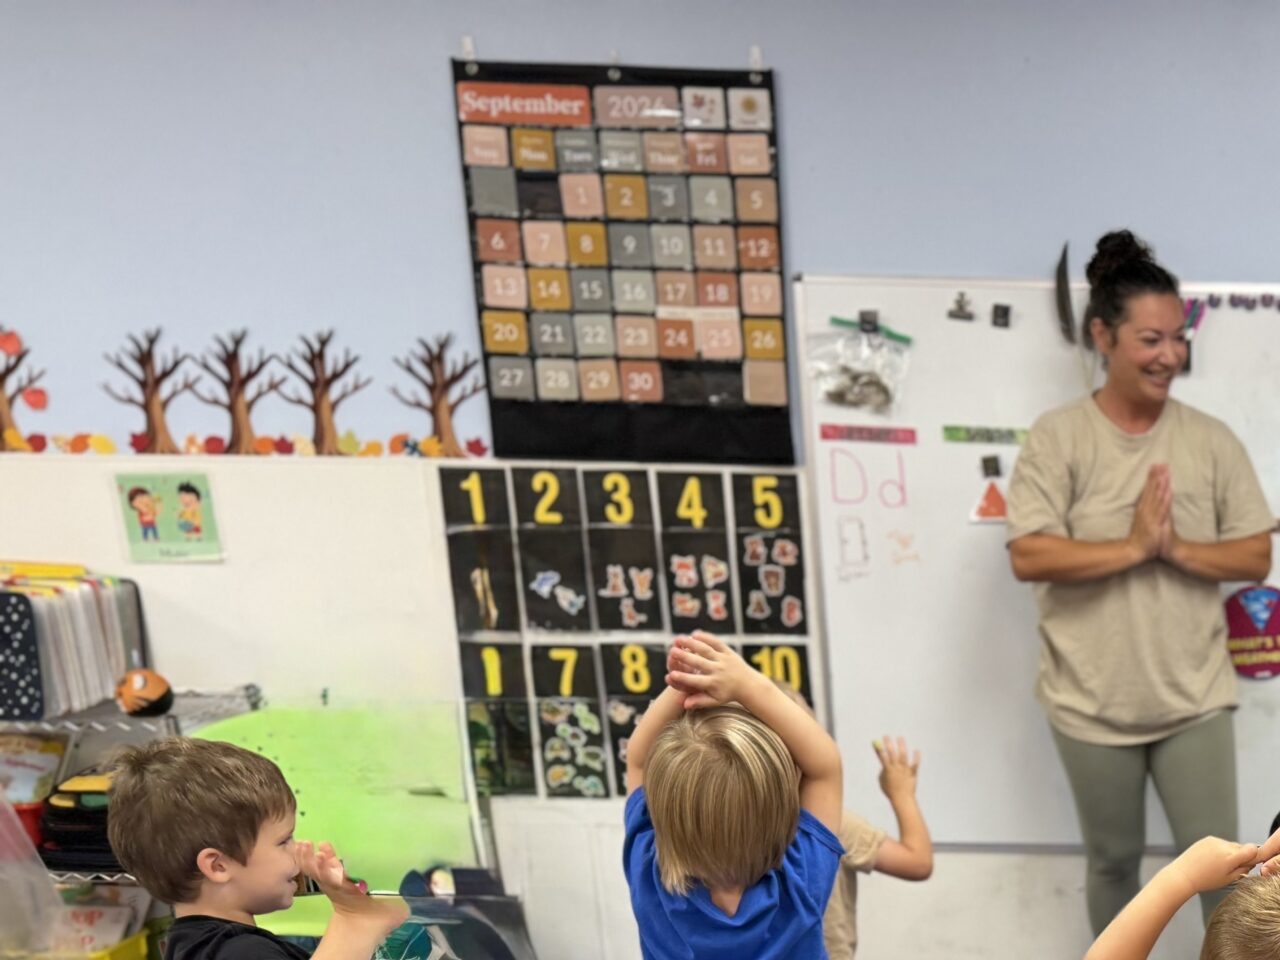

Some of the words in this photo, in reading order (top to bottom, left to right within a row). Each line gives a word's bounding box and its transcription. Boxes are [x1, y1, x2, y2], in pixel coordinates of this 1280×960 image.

[462, 89, 584, 117] September
[575, 187, 587, 204] 1
[619, 187, 633, 206] 2
[661, 187, 675, 206] 3
[704, 189, 717, 207] 4
[750, 191, 763, 209] 5
[490, 232, 505, 250] 6
[537, 234, 551, 252] 7
[580, 234, 594, 253] 8
[623, 235, 637, 253] 9
[660, 236, 683, 255] 10
[703, 237, 725, 257] 11
[748, 238, 770, 258] 12
[493, 278, 518, 296] 13
[536, 280, 561, 298] 14
[580, 281, 604, 299] 15
[622, 281, 647, 300] 16
[664, 282, 687, 300] 17
[705, 283, 729, 301] 18
[750, 284, 773, 303] 19
[493, 323, 519, 342] 20
[540, 325, 564, 343] 21
[583, 326, 607, 345] 22
[624, 327, 649, 347] 23
[664, 328, 689, 348] 24
[708, 328, 733, 348] 25
[752, 330, 776, 349] 26
[500, 368, 524, 387] 27
[545, 370, 569, 388] 28
[587, 370, 611, 389] 29
[627, 371, 652, 390] 30
[460, 471, 486, 525] 1
[531, 471, 563, 524] 2
[602, 472, 634, 525] 3
[676, 476, 708, 528] 4
[752, 476, 784, 529] 5
[549, 649, 578, 697] 7
[620, 644, 651, 693] 8
